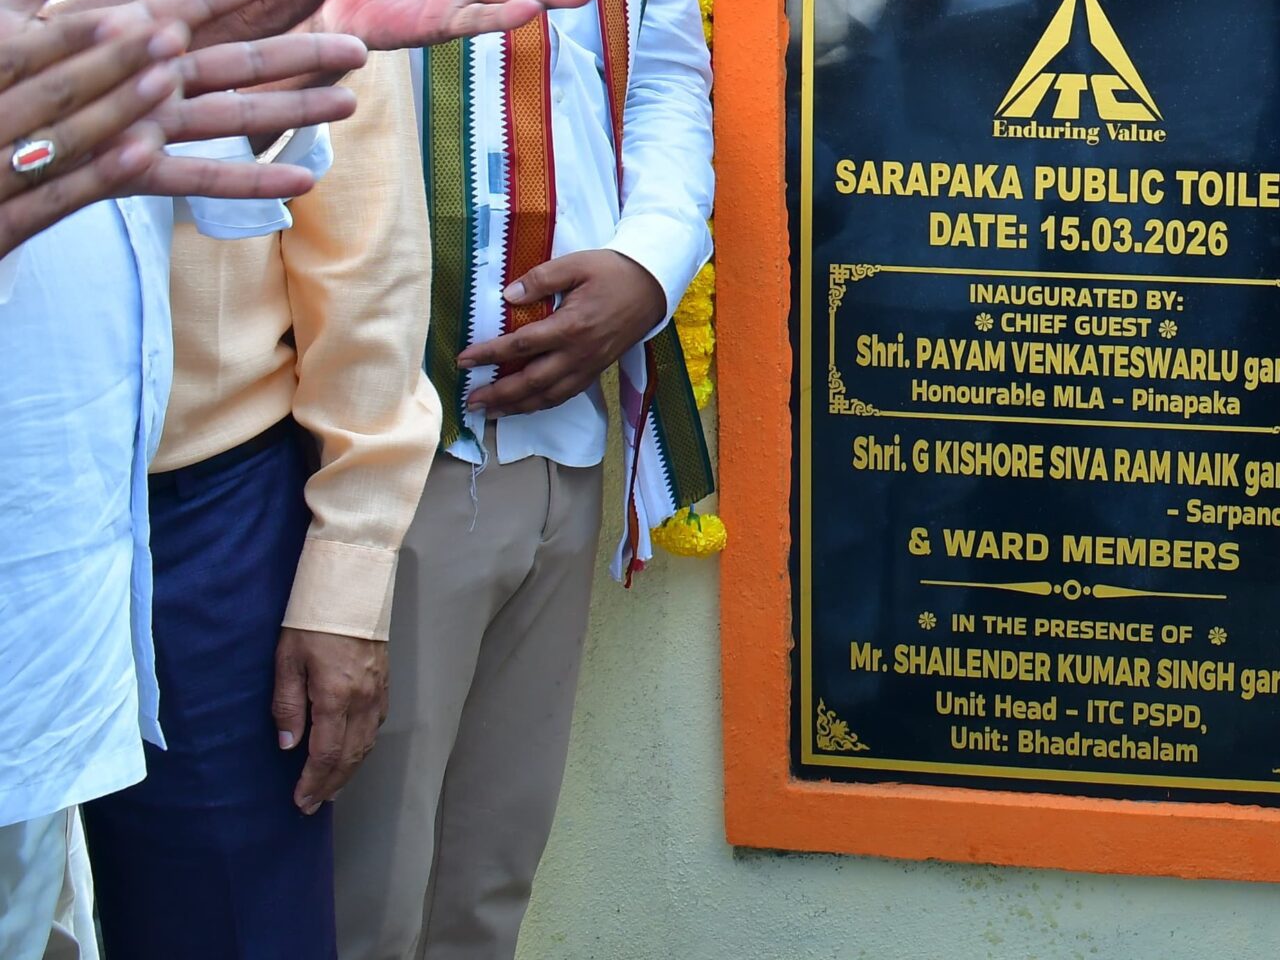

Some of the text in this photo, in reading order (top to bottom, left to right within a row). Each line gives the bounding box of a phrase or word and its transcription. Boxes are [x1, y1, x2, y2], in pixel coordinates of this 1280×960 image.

[1001, 72, 1158, 121] ITC
[993, 119, 1166, 145] Enduring Value
[836, 160, 1023, 199] SARAPAKA
[1035, 167, 1164, 204] PUBLIC
[930, 212, 1228, 256] DATE: 15.03.2026
[970, 285, 1182, 310] INAUGURATED BY:
[1001, 313, 1150, 336] CHIEF GUEST
[856, 335, 910, 367] Shri.
[917, 338, 1005, 371] PAYAM
[1012, 343, 1238, 381] VENKATESWARLU
[912, 381, 1045, 406] Honourable
[1054, 386, 1104, 408] MLA
[1132, 389, 1241, 419] Pinapaka
[853, 436, 906, 471] Shri.
[913, 440, 928, 472] G
[936, 442, 1043, 478] KISHORE
[1050, 446, 1107, 480] SIVA
[1115, 449, 1170, 483] RAM
[1178, 452, 1238, 486] NAIK
[909, 528, 1239, 570] & WARD MEMBERS
[953, 616, 1193, 643] IN THE PRESENCE OF
[851, 642, 888, 673] Mr.
[895, 645, 1050, 681] SHAILENDER
[1058, 655, 1150, 687] KUMAR
[1157, 659, 1234, 691] SINGH
[937, 693, 985, 716] Unit
[995, 697, 1056, 720] Head
[1088, 701, 1123, 724] ITC
[1133, 702, 1207, 734] PSPD,
[952, 726, 1198, 761] Unit: Bhadrachalam
